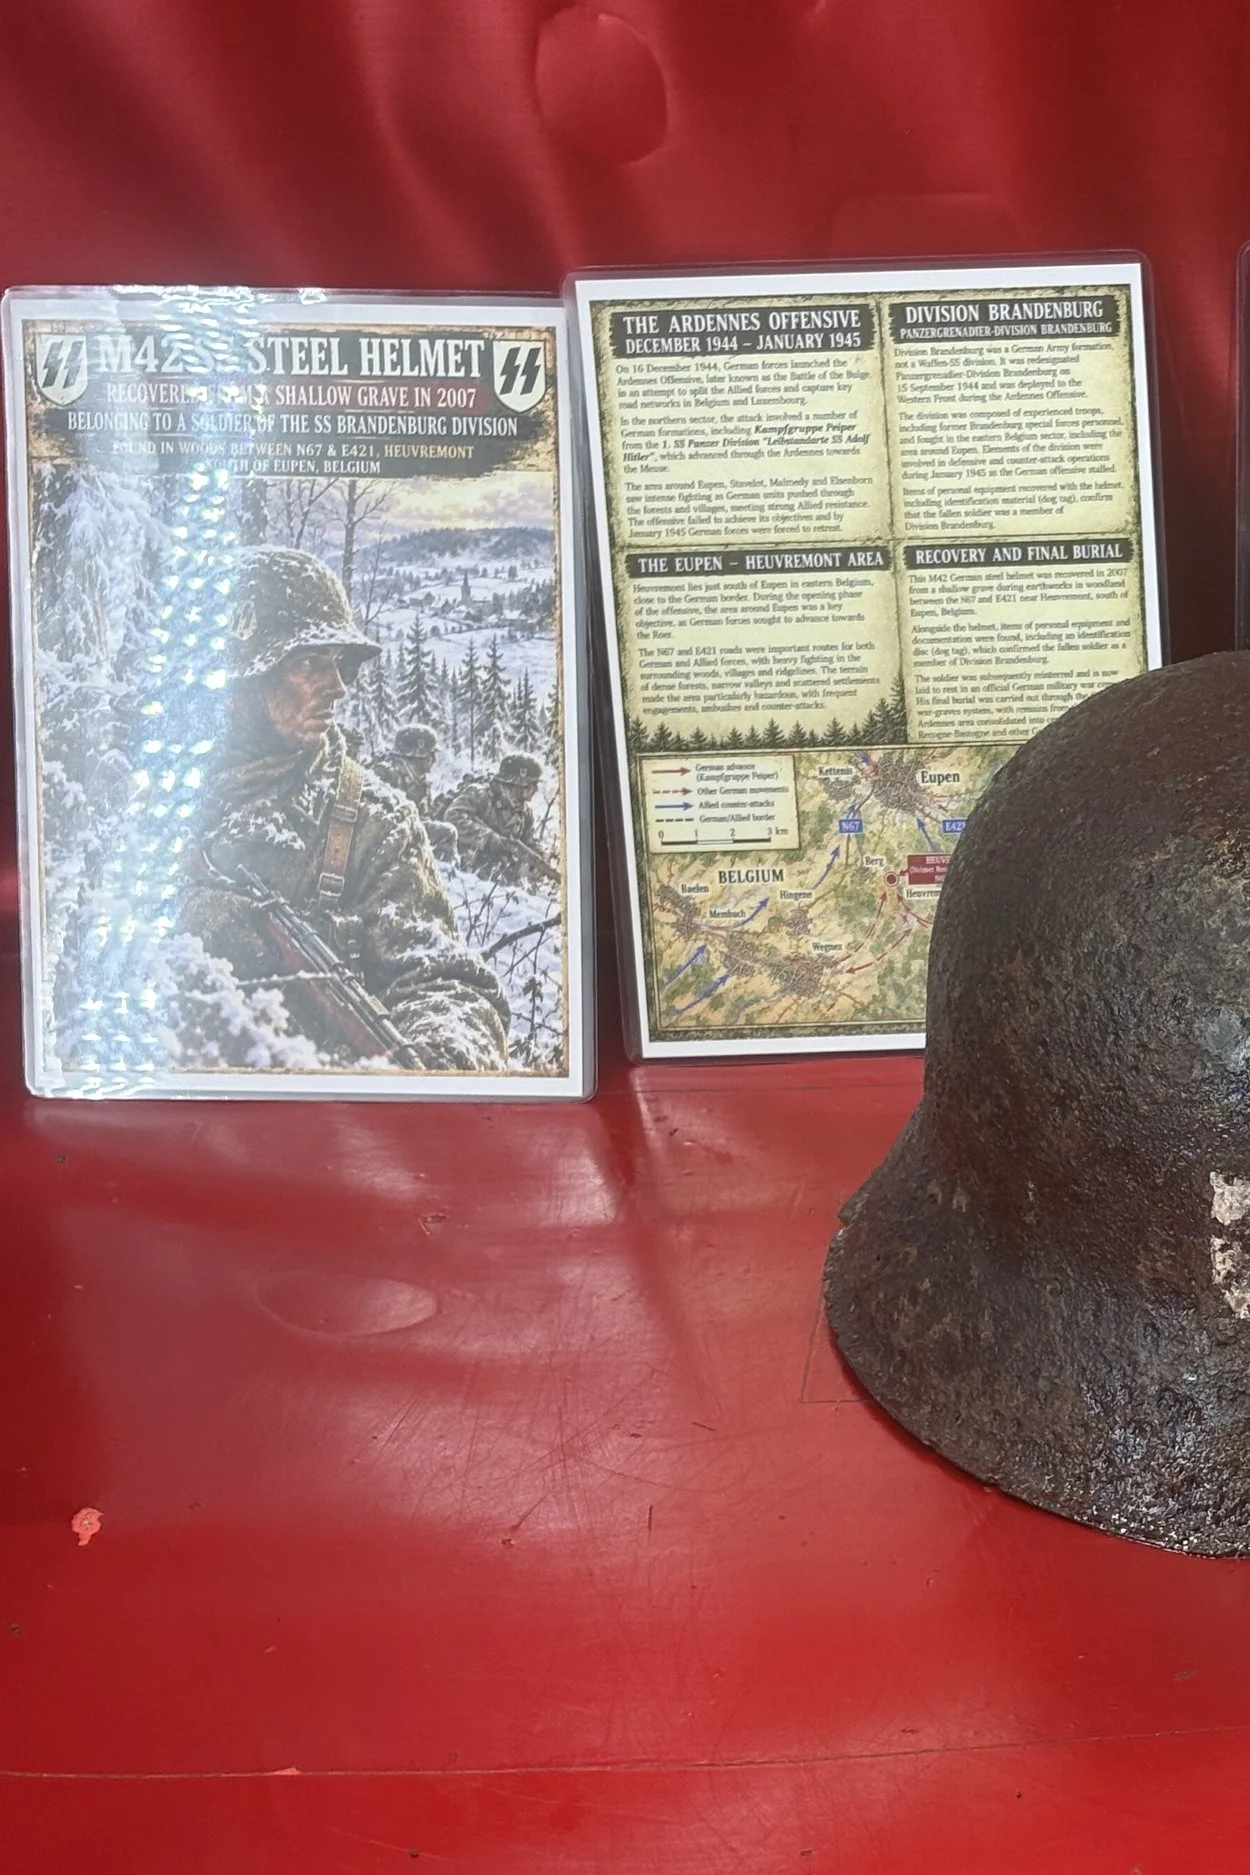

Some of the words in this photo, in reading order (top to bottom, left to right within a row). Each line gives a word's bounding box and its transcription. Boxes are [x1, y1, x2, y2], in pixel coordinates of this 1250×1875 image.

[623, 315, 659, 335] THE
[669, 313, 760, 333] ARDENNES
[768, 310, 861, 330] OFFENSIVE
[906, 305, 979, 324] DIVISION
[988, 301, 1103, 321] BRANDENBURG
[1040, 322, 1112, 335] BRANDENBURG
[626, 336, 700, 354] DECEMBER
[707, 335, 737, 352] 1944
[756, 333, 822, 350] JANUARY
[830, 332, 861, 348] 1945
[246, 336, 348, 376] STEEL
[359, 338, 485, 378] HELMET
[275, 385, 351, 407] SHALLOW
[358, 387, 408, 408] GRAVE
[414, 388, 430, 408] IN
[437, 388, 475, 408] 2007
[68, 411, 149, 431] BELONGING
[155, 412, 171, 432] TO
[176, 413, 185, 432] A
[257, 414, 275, 433] OF
[282, 414, 308, 433] THE
[314, 415, 330, 434] SS
[337, 415, 446, 435] BRANDENBURG
[452, 417, 518, 437] DIVISION
[253, 459, 270, 473] OF
[323, 460, 380, 474] BELGIUM
[639, 558, 668, 573] THE
[675, 556, 722, 572] EUPEN
[745, 552, 840, 570] HEUVREMONT
[848, 551, 883, 567] AREA
[916, 546, 986, 565] RECOVERY
[992, 545, 1021, 563] AND
[1027, 544, 1067, 562] FINAL
[1072, 543, 1122, 560] BURIAL
[921, 771, 960, 786] Eupen
[842, 821, 860, 831] N67
[718, 869, 784, 884] BELGIUM
